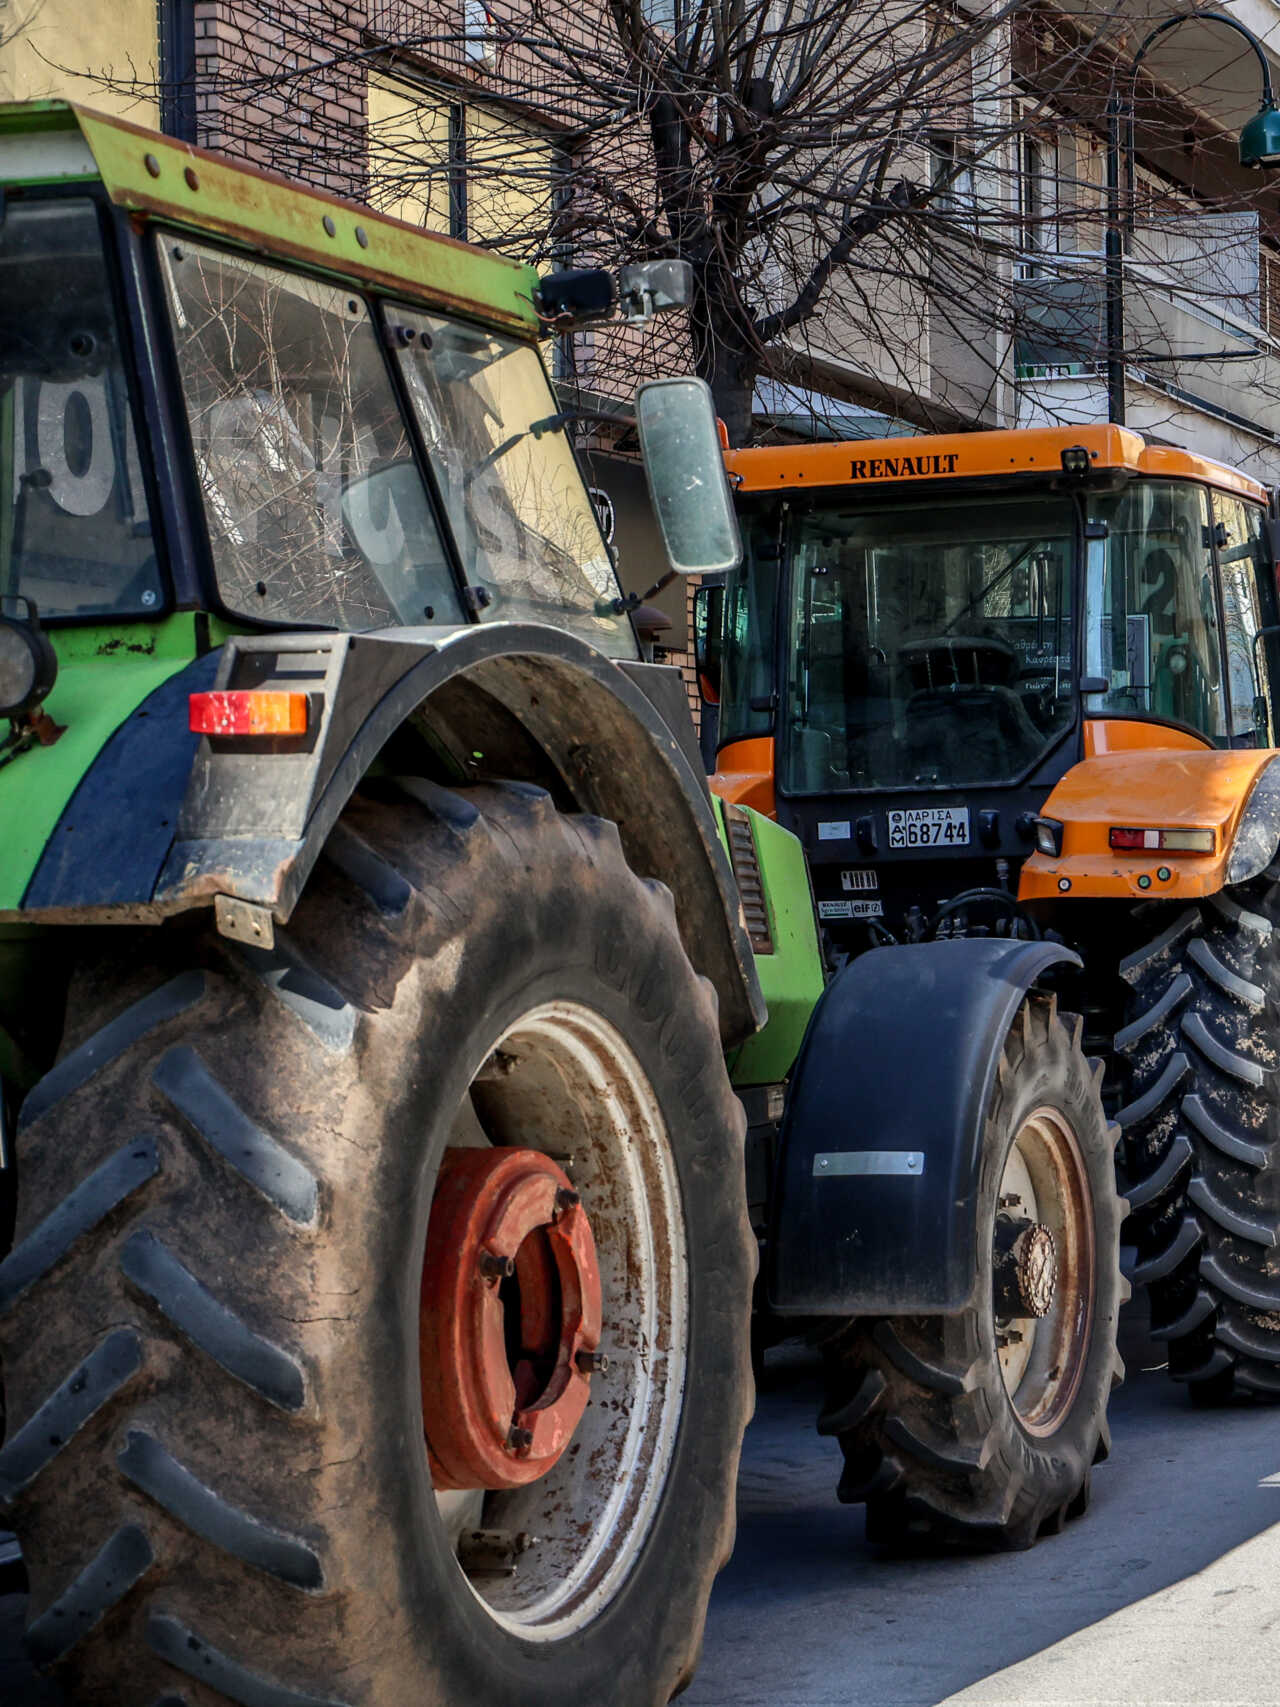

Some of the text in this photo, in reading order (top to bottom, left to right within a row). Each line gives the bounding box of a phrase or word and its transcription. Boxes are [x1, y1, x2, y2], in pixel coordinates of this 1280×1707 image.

[850, 453, 960, 480] RENAULT
[907, 810, 953, 822] ΛΑΡΙΣΑ
[908, 822, 967, 844] 68744
